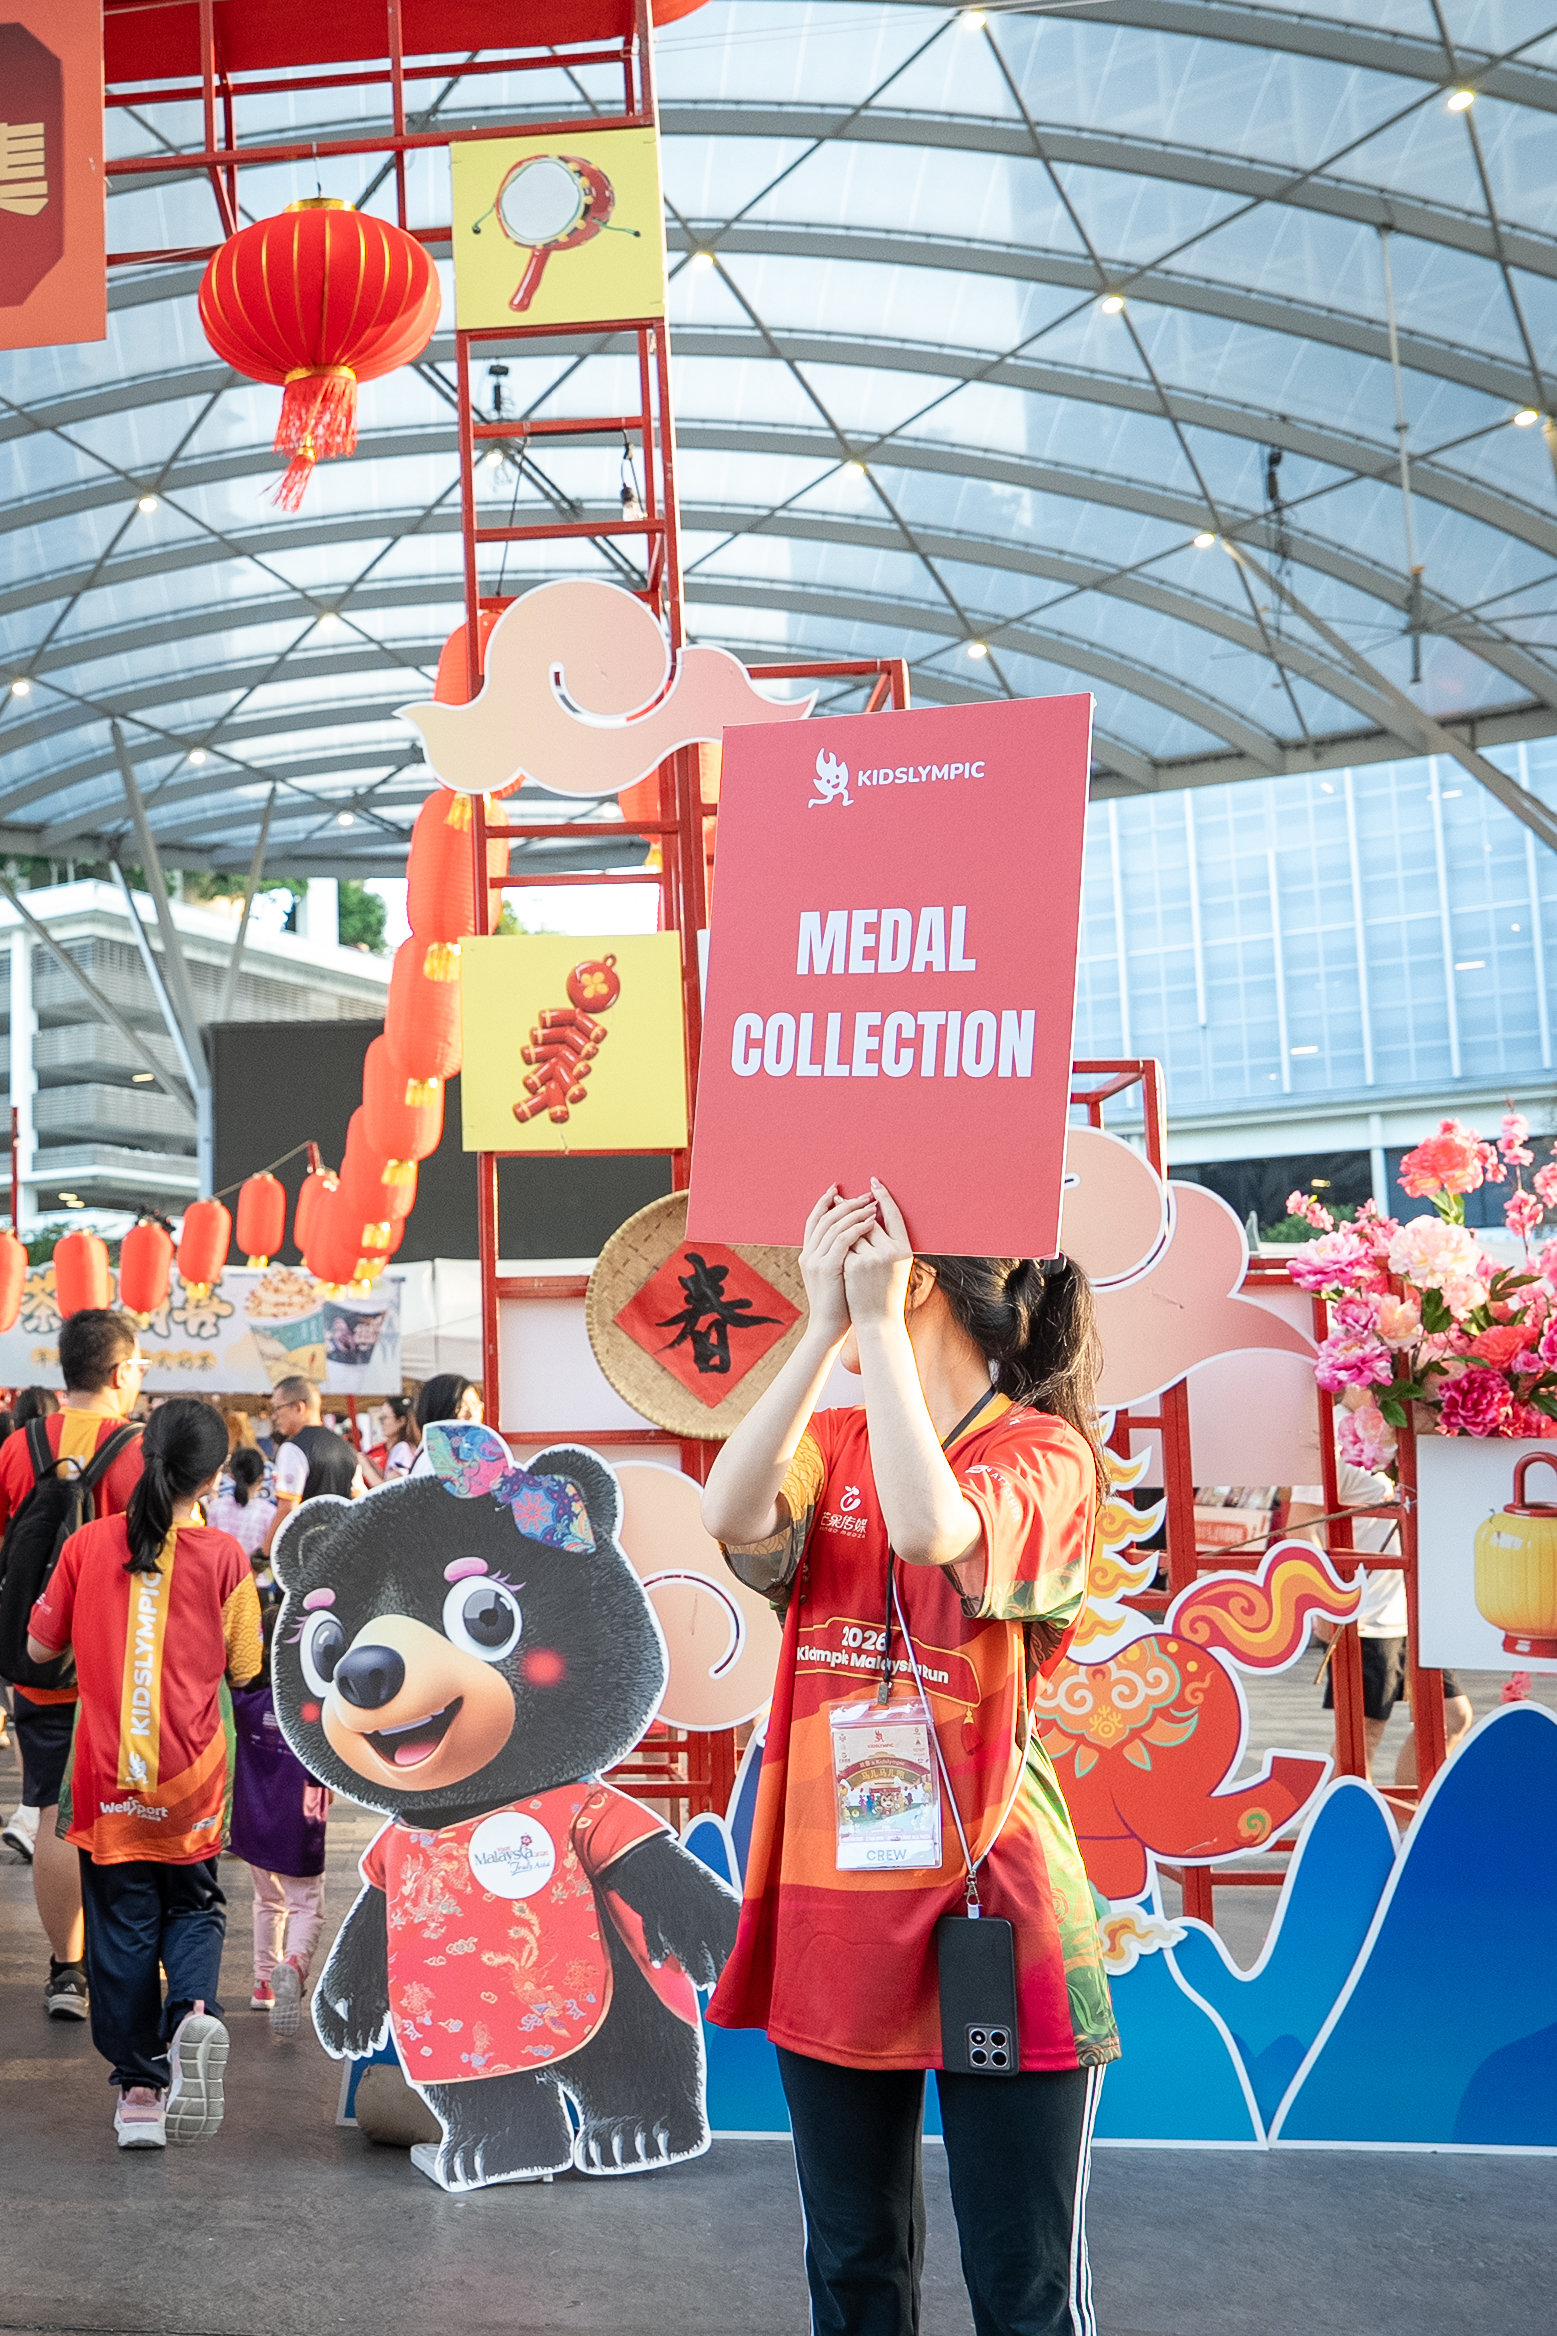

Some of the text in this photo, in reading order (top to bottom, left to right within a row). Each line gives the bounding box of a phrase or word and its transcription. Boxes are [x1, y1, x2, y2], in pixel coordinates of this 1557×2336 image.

[857, 760, 986, 787] KIDSLYMPIC
[796, 905, 977, 975] MEDAL
[730, 1009, 1036, 1078] COLLECTION
[654, 1252, 785, 1374] 春
[129, 1572, 162, 1736] KIDSLYMPIC
[841, 1625, 887, 1651] 2026
[922, 1664, 950, 1684] Run
[866, 1849, 907, 1862] CREW
